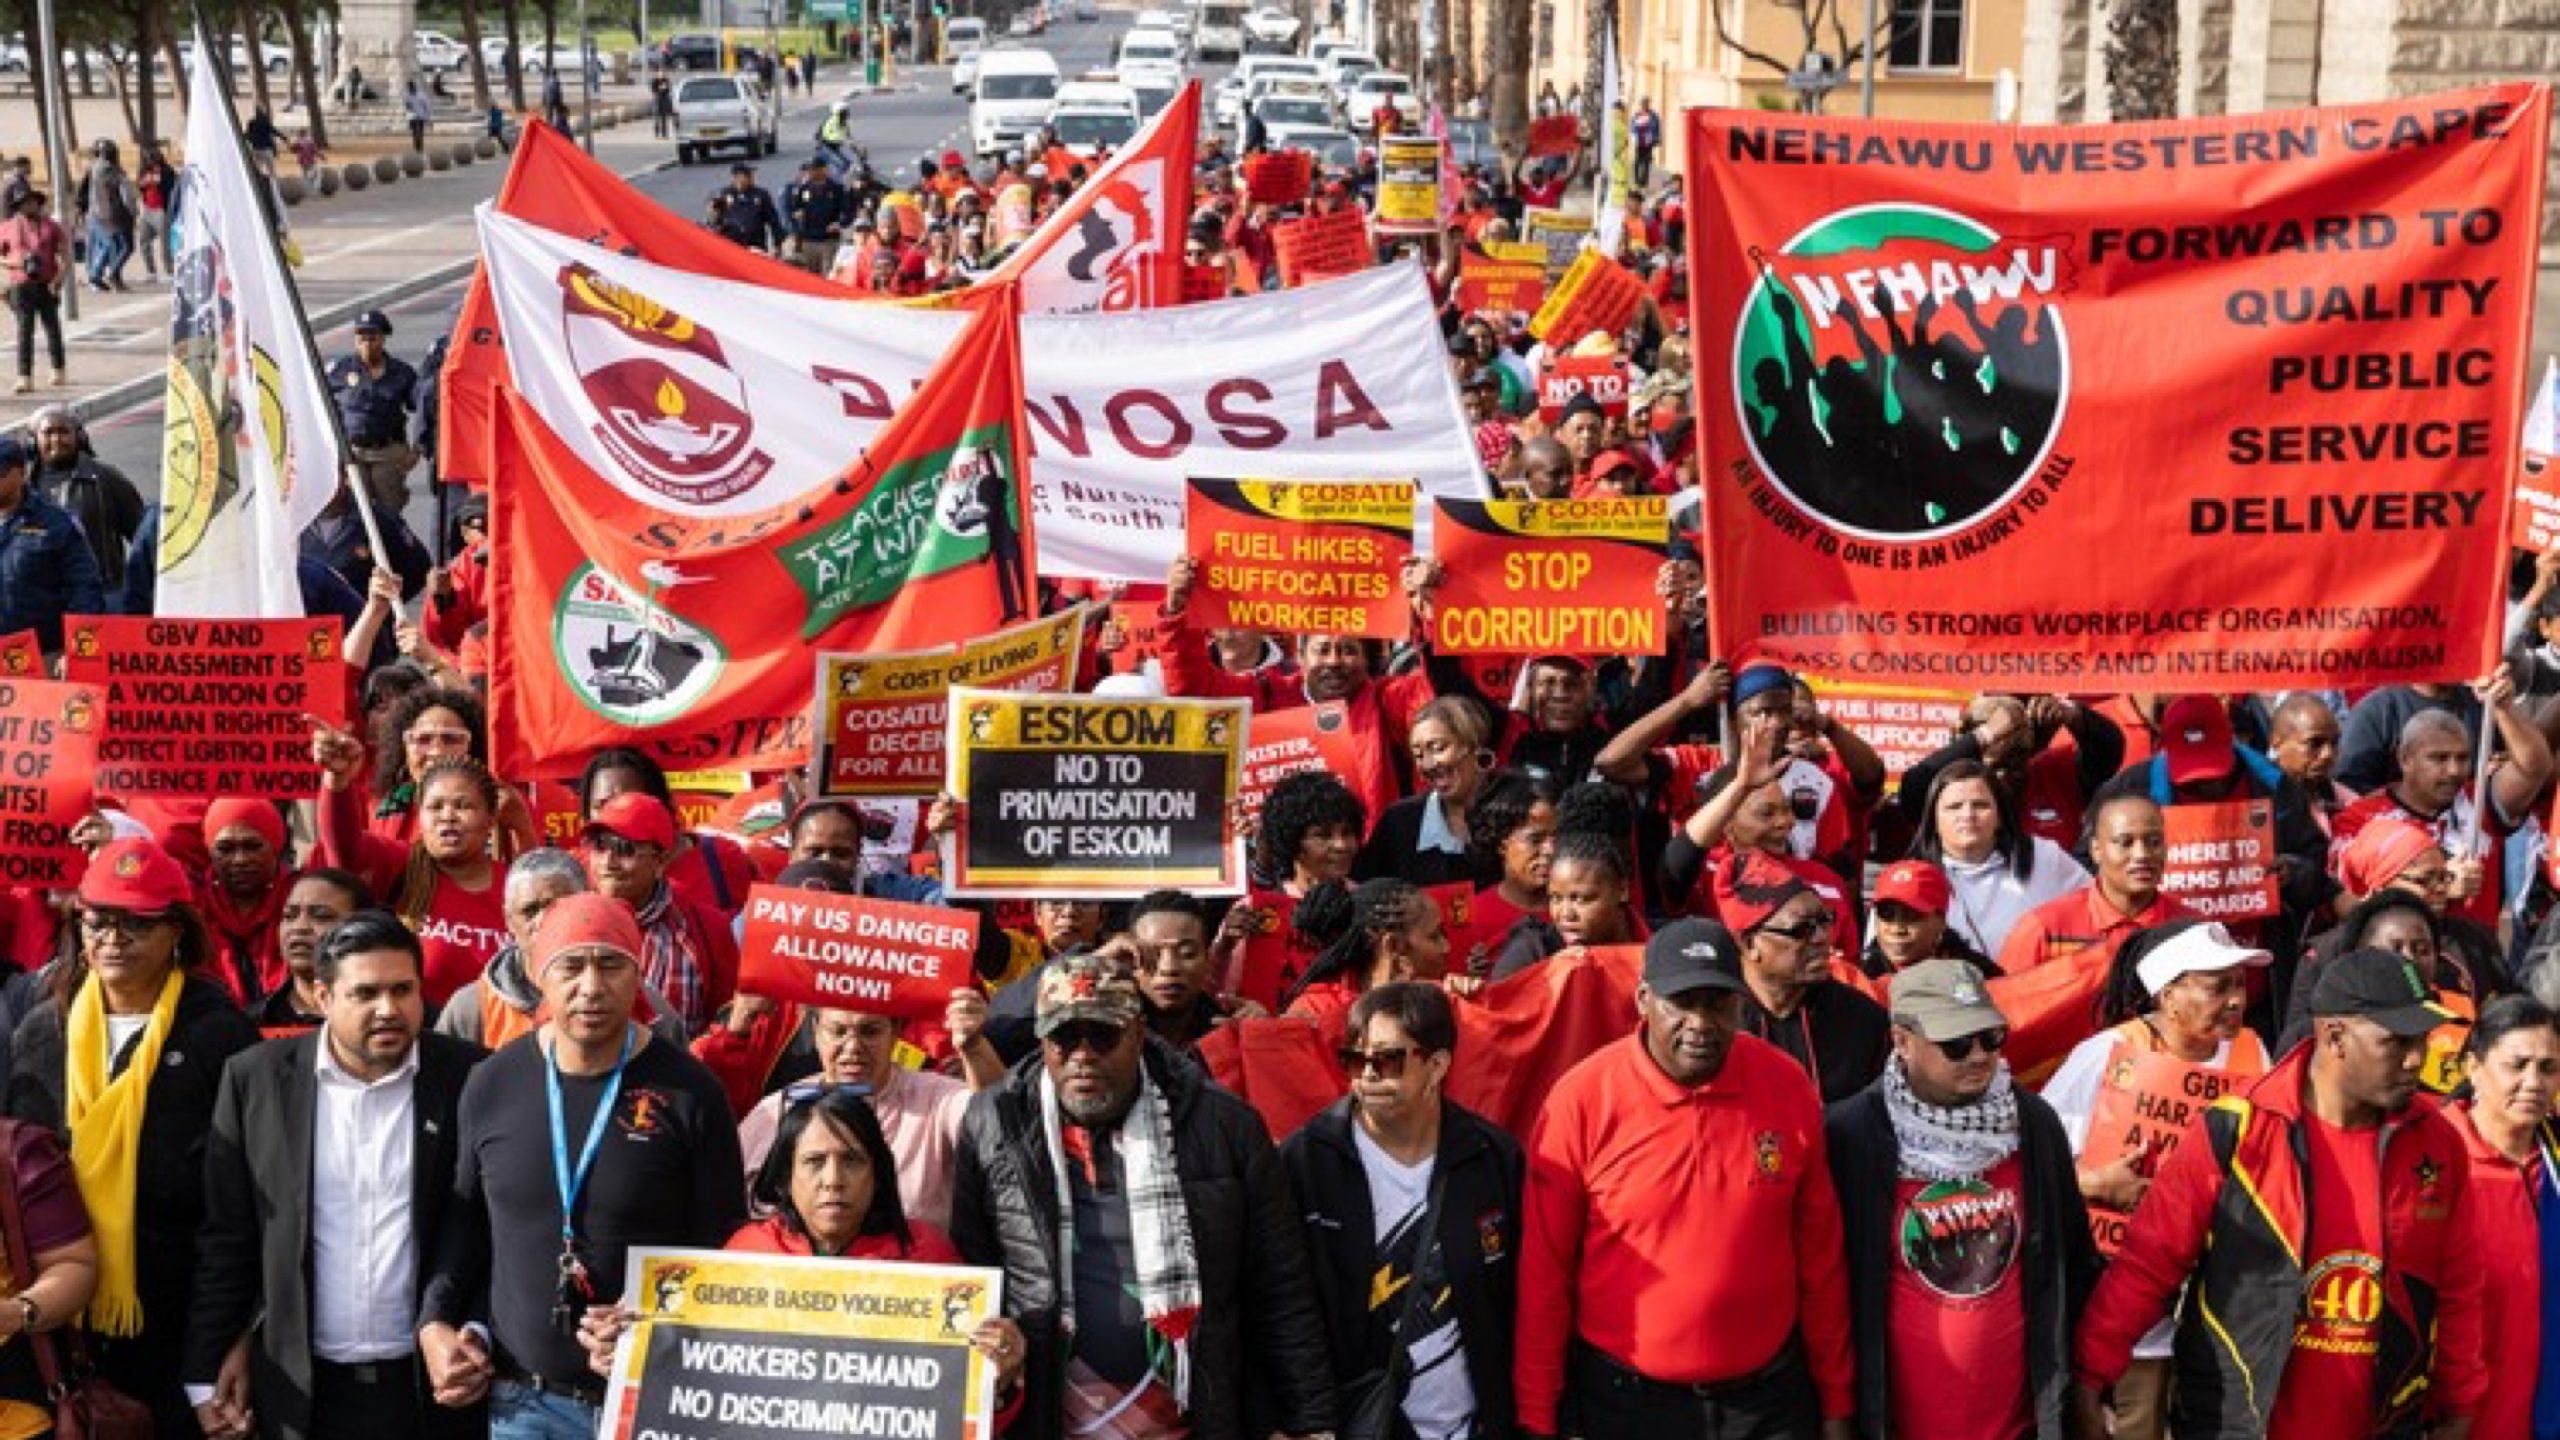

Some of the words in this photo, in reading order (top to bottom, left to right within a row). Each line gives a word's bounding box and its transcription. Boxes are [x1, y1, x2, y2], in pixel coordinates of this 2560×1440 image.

[1728, 126, 1992, 172] NEHAWU
[2014, 124, 2319, 173] WESTERN
[2344, 101, 2512, 152] CAPE
[2088, 213, 2398, 265] FORWARD
[2419, 207, 2502, 247] TO
[1791, 247, 2056, 328] NEHAWU
[2225, 277, 2499, 327] QUALITY
[2269, 348, 2495, 393] PUBLIC
[1546, 377, 1583, 400] NO
[1587, 375, 1623, 396] TO
[2228, 418, 2490, 465] SERVICE
[1298, 482, 1415, 504] COSATU
[1548, 498, 1667, 520] COSATU
[1751, 484, 1812, 543] INJURY
[1816, 529, 1839, 557] TO
[1842, 542, 1885, 568] ONE
[1890, 547, 1913, 571] IS
[1917, 545, 1948, 569] AN
[1951, 508, 2025, 562] INJURY
[2020, 487, 2048, 514] TO
[2041, 453, 2076, 494] ALL
[2189, 488, 2487, 535] DELIVERY
[1213, 531, 1284, 562] FUEL
[1292, 537, 1384, 567] HIKES;
[1207, 566, 1391, 598] SUFFOCATES
[1504, 551, 1592, 591] STOP
[1228, 600, 1367, 633] WORKERS
[1440, 607, 1654, 649] CORRUPTION
[1760, 611, 1897, 636] BUILDING
[1905, 611, 2024, 636] STRONG
[2030, 607, 2211, 637] WORKPLACE
[146, 624, 199, 647] GBV
[207, 624, 264, 647] AND
[108, 652, 275, 677] HARASSMENT
[282, 652, 305, 677] IS
[884, 668, 943, 691] COST
[948, 663, 974, 684] OF
[978, 642, 1039, 674] LIVING
[1850, 650, 2086, 676] CONSCIOUSNESS
[2092, 650, 2157, 675] AND
[2167, 645, 2446, 675] INTERNATIONALISM
[108, 683, 125, 704] A
[131, 683, 266, 705] VIOLATION
[272, 682, 308, 704] OF
[29, 719, 55, 746] IS
[107, 709, 206, 735] HUMAN
[1020, 705, 1176, 745] ESKOM
[13, 749, 52, 779] OF
[95, 768, 209, 791] VIOLENCE
[216, 768, 243, 790] AT
[838, 757, 889, 777] FOR
[899, 754, 942, 777] ALL
[1054, 754, 1098, 784] NO
[1106, 754, 1143, 784] TO
[999, 790, 1197, 821] PRIVATISATION
[545, 811, 582, 839] ST
[1023, 825, 1063, 856] OF
[1070, 825, 1172, 856] ESKOM
[2236, 838, 2261, 858] TO
[0, 853, 67, 881] ORK
[2225, 865, 2265, 887] AND
[753, 898, 808, 926] PAY
[814, 908, 851, 932] US
[856, 913, 971, 951] DANGER
[772, 934, 942, 979] ALLOWANCE
[814, 971, 892, 1002] NOW!
[693, 1284, 771, 1307] GENDER
[774, 1290, 838, 1312] BASED
[842, 1295, 934, 1319] VIOLENCE
[2313, 1276, 2383, 1322] 40
[681, 1337, 818, 1381] WORKERS
[823, 1351, 941, 1389] DEMAND
[668, 1386, 713, 1419] NO
[719, 1393, 938, 1440] DISCRIMINATION
